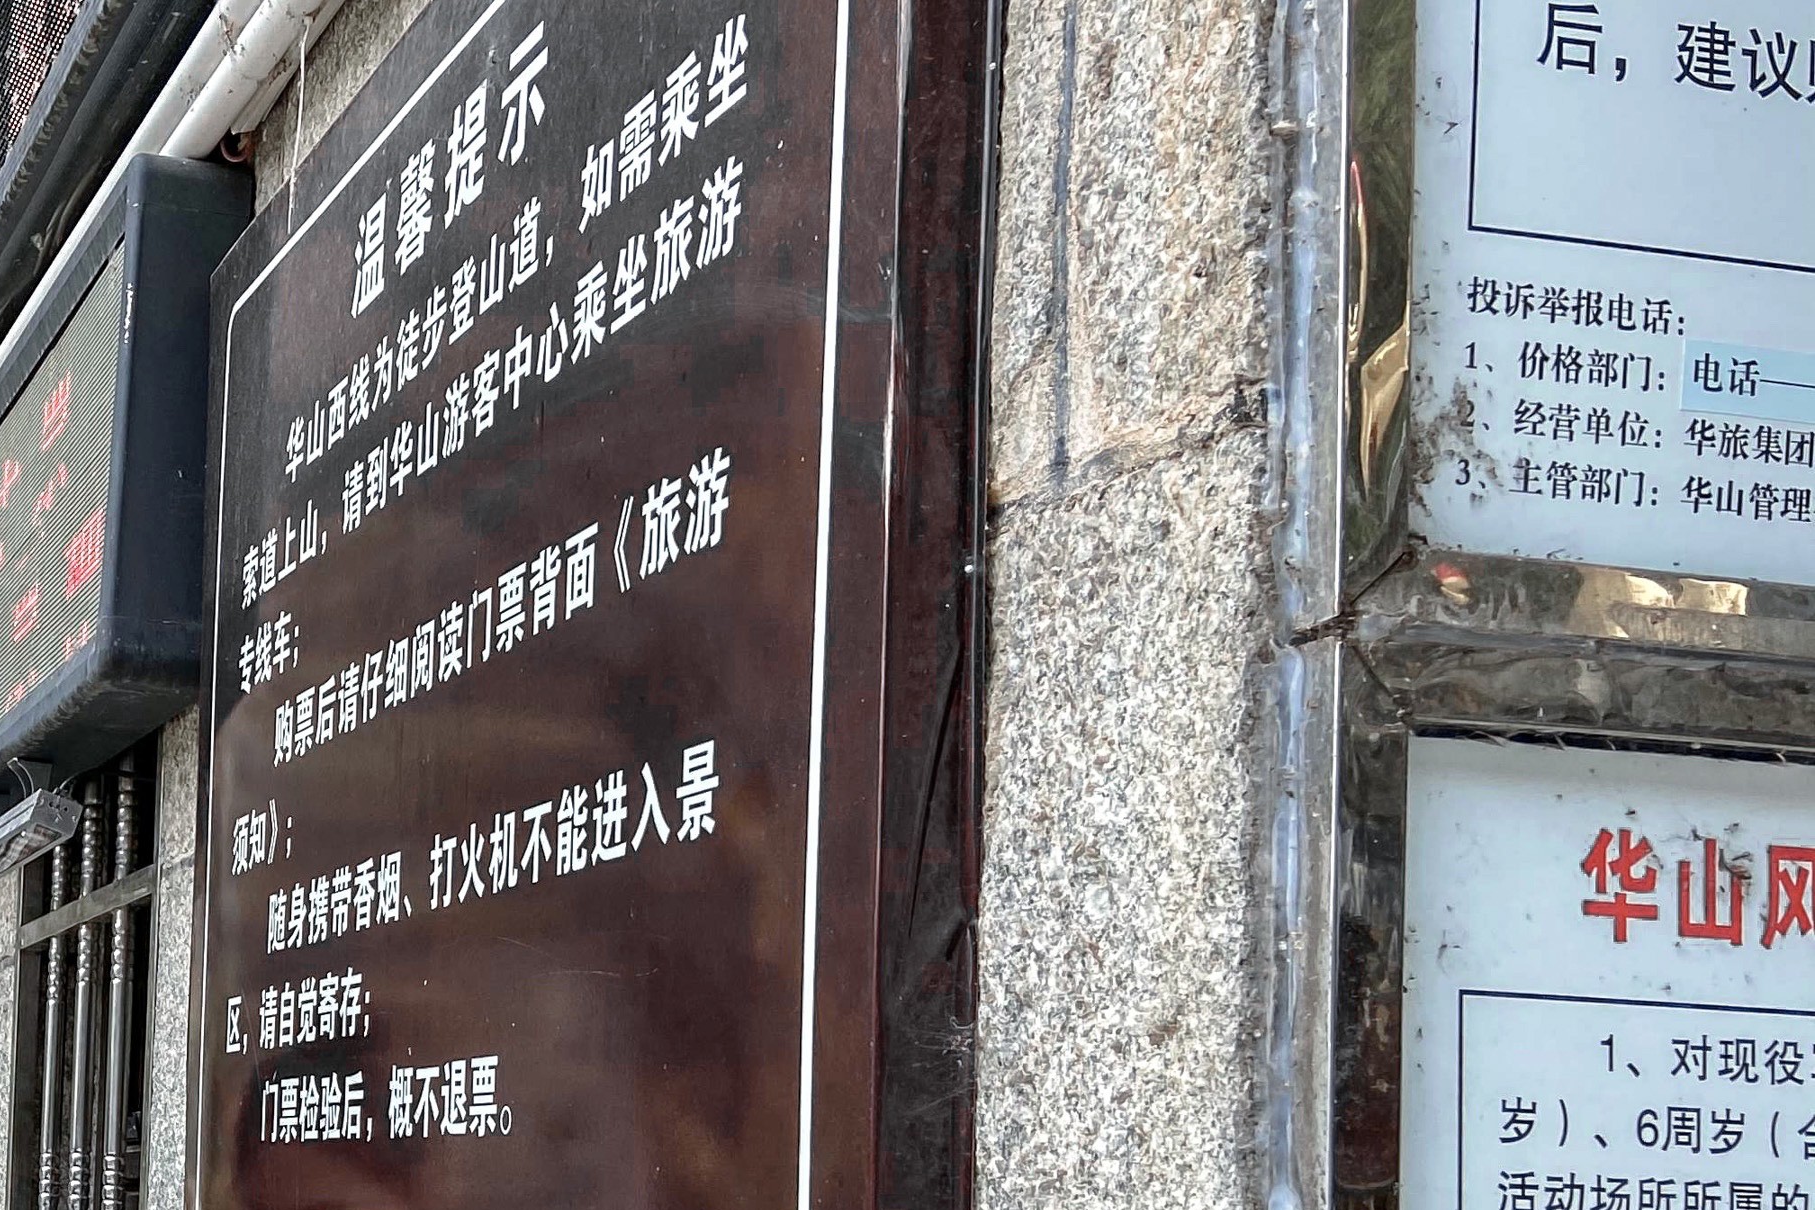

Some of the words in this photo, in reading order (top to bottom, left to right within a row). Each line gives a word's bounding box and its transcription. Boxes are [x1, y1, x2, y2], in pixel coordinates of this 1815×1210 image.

[1537, 2, 1815, 101] 后，建议
[350, 21, 550, 318] 温馨提示
